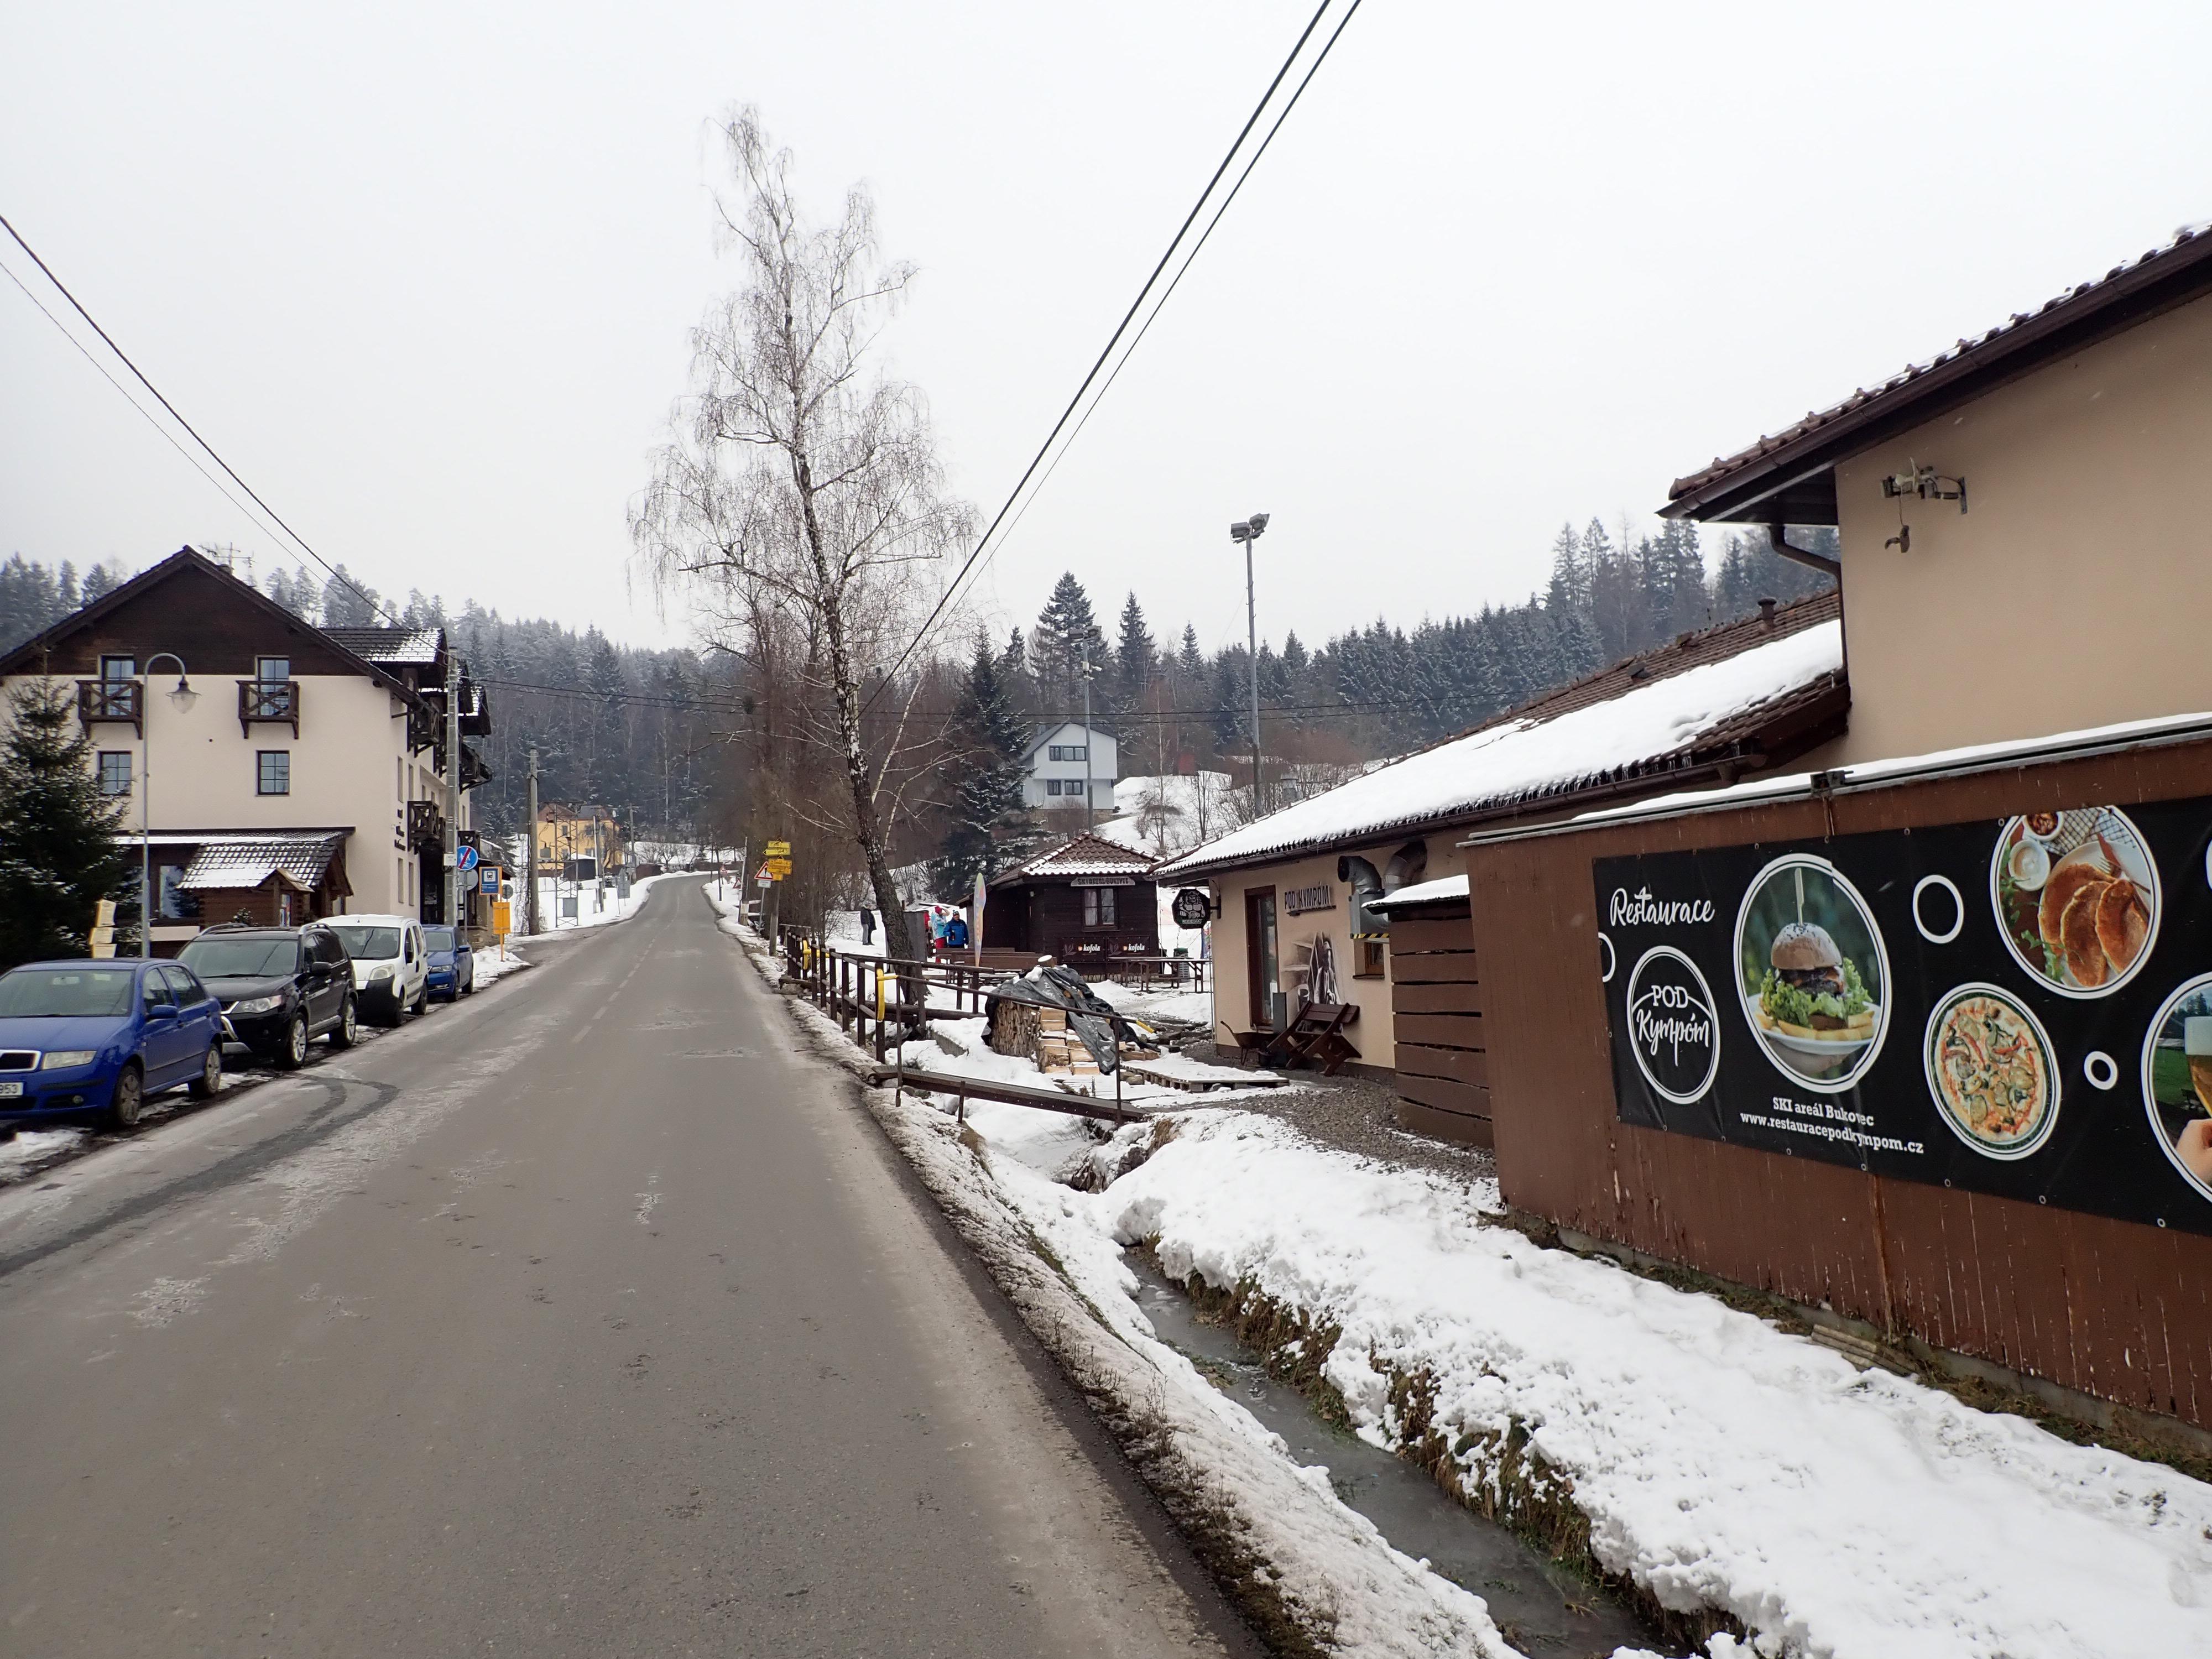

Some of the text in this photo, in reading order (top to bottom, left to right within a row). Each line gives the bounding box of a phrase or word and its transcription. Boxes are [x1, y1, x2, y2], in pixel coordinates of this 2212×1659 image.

[1285, 891, 1296, 910] POD
[1610, 886, 1715, 926] Restaurace
[1083, 943, 1100, 953] kofola
[1128, 943, 1145, 952] kofola
[1651, 985, 1688, 1008] POD
[1636, 1009, 1709, 1066] Kympóm
[1772, 1097, 1874, 1126] SKI areál Bukovec
[1740, 1113, 1924, 1154] www.restauracepodkympom.cz
